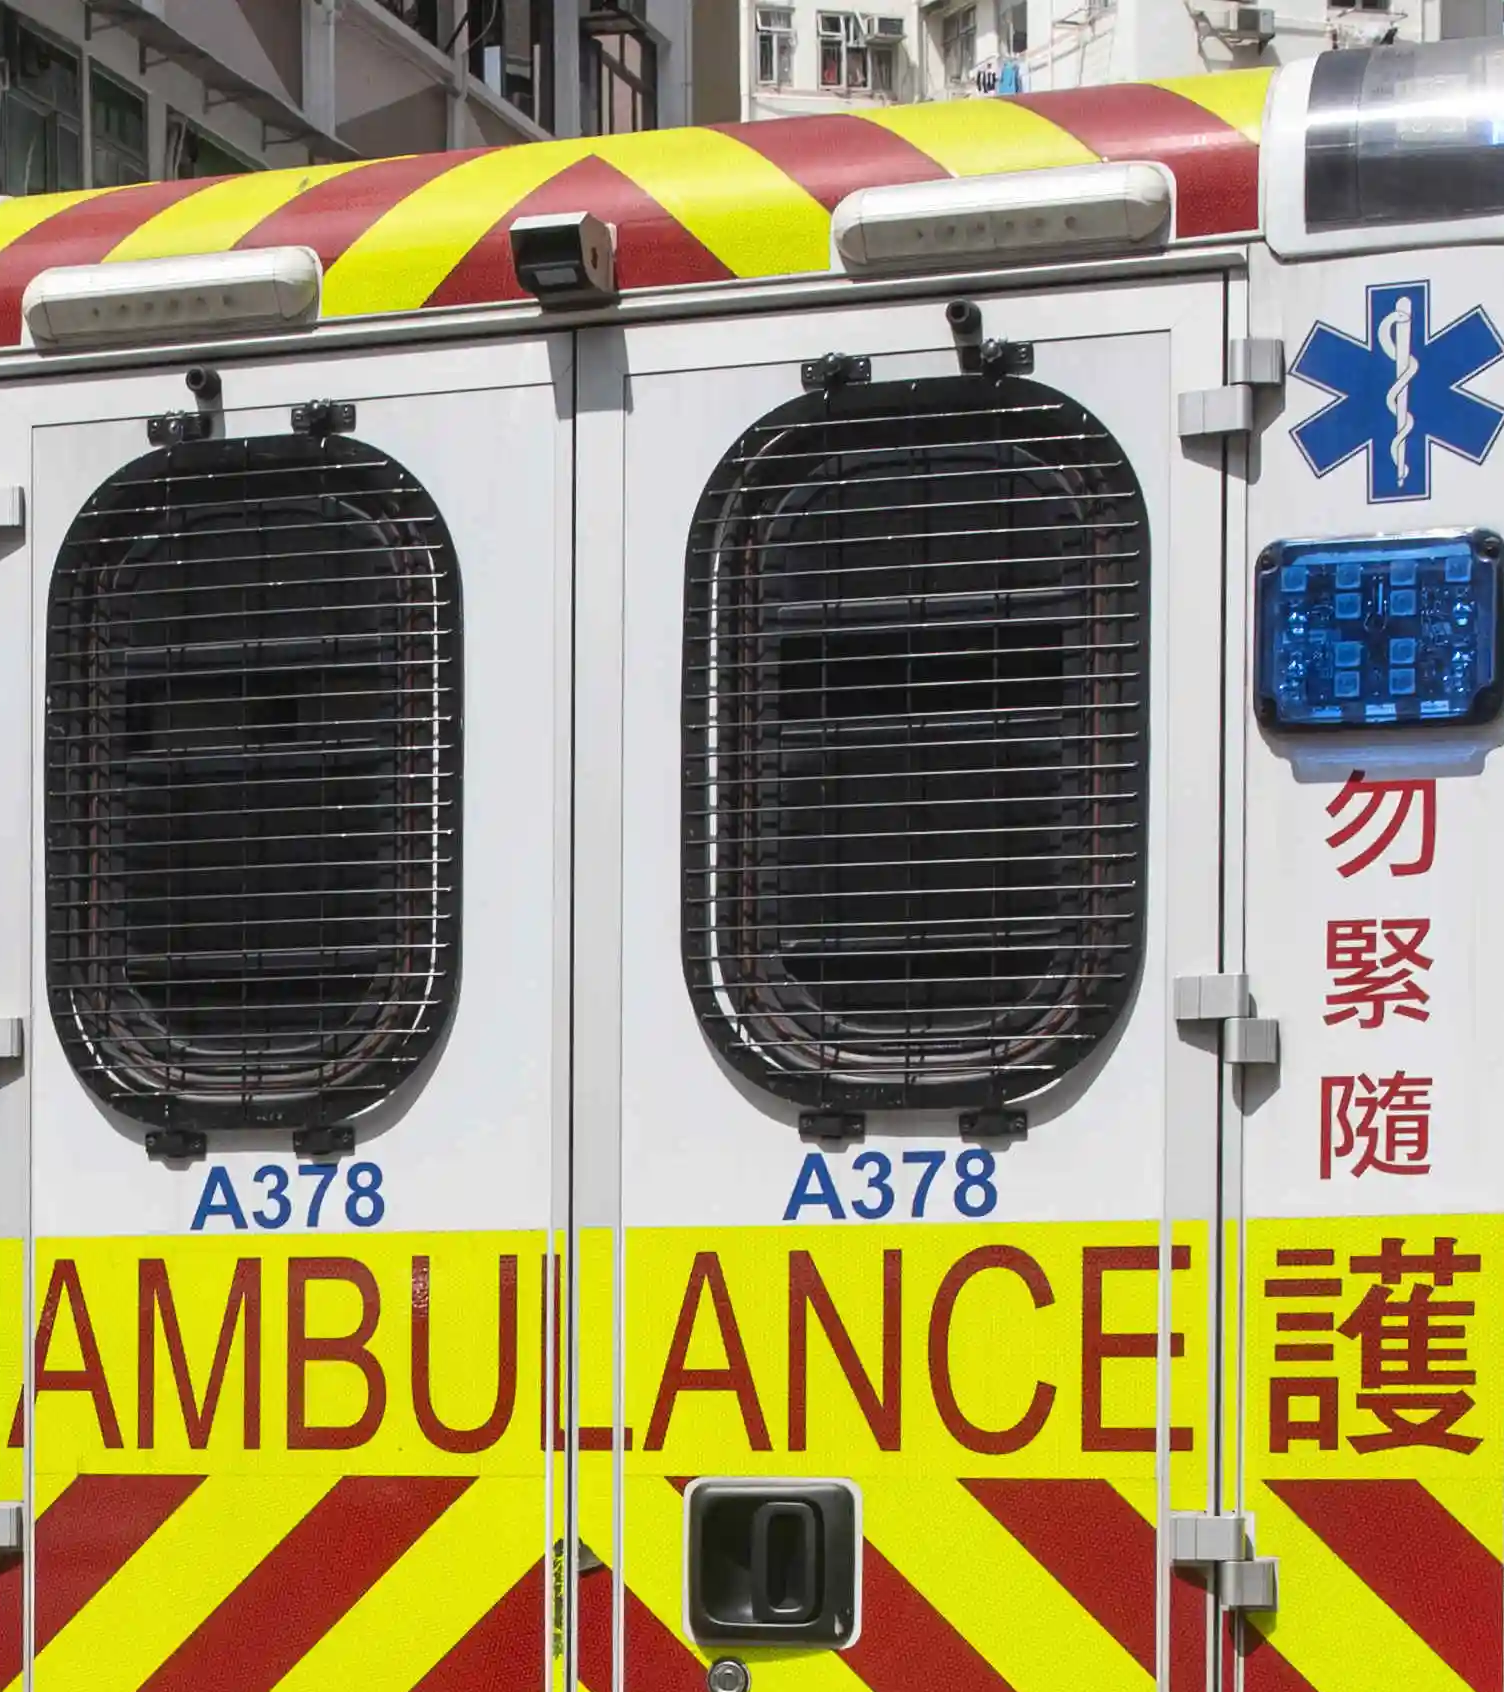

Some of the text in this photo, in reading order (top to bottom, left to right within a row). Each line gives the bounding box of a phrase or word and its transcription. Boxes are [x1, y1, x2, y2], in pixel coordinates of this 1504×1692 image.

[1320, 768, 1438, 1181] 勿緊隨
[189, 1161, 386, 1232] A378
[782, 1148, 997, 1221] A378
[7, 1244, 1193, 1455] AMBULANCE
[1263, 1236, 1483, 1456] 護
